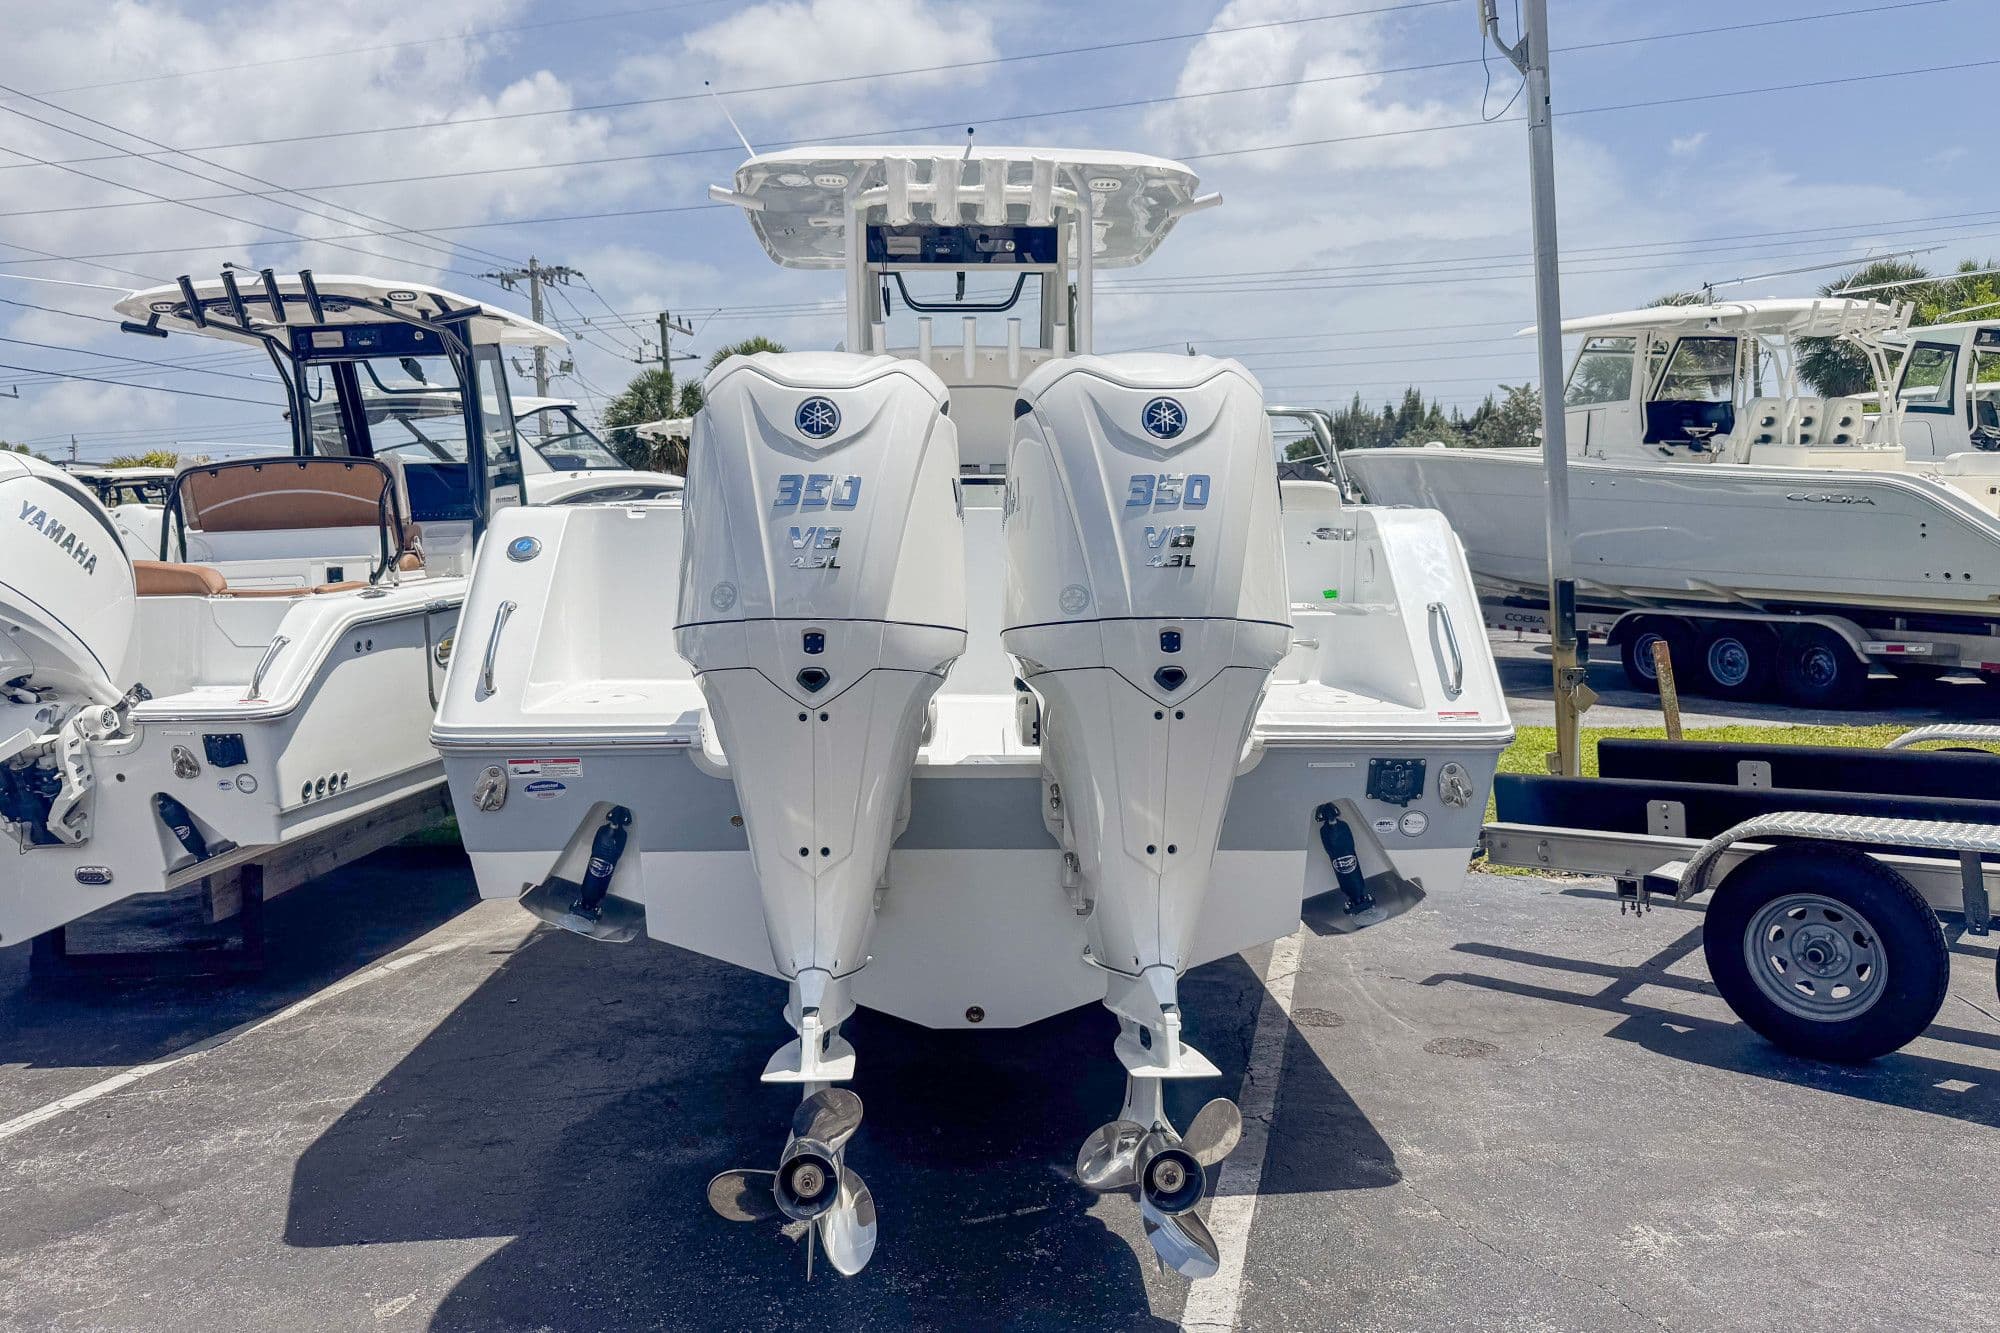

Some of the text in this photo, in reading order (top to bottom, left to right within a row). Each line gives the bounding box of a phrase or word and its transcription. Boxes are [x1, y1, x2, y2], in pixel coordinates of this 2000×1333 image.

[774, 474, 861, 506] 350
[1126, 474, 1211, 506] 350
[1786, 492, 1876, 506] COBIA
[19, 500, 97, 576] YAMAHA
[789, 527, 842, 550] V6
[1144, 526, 1196, 549] V6
[1145, 554, 1196, 568] 4.3L
[1505, 612, 1545, 624] COBIA
